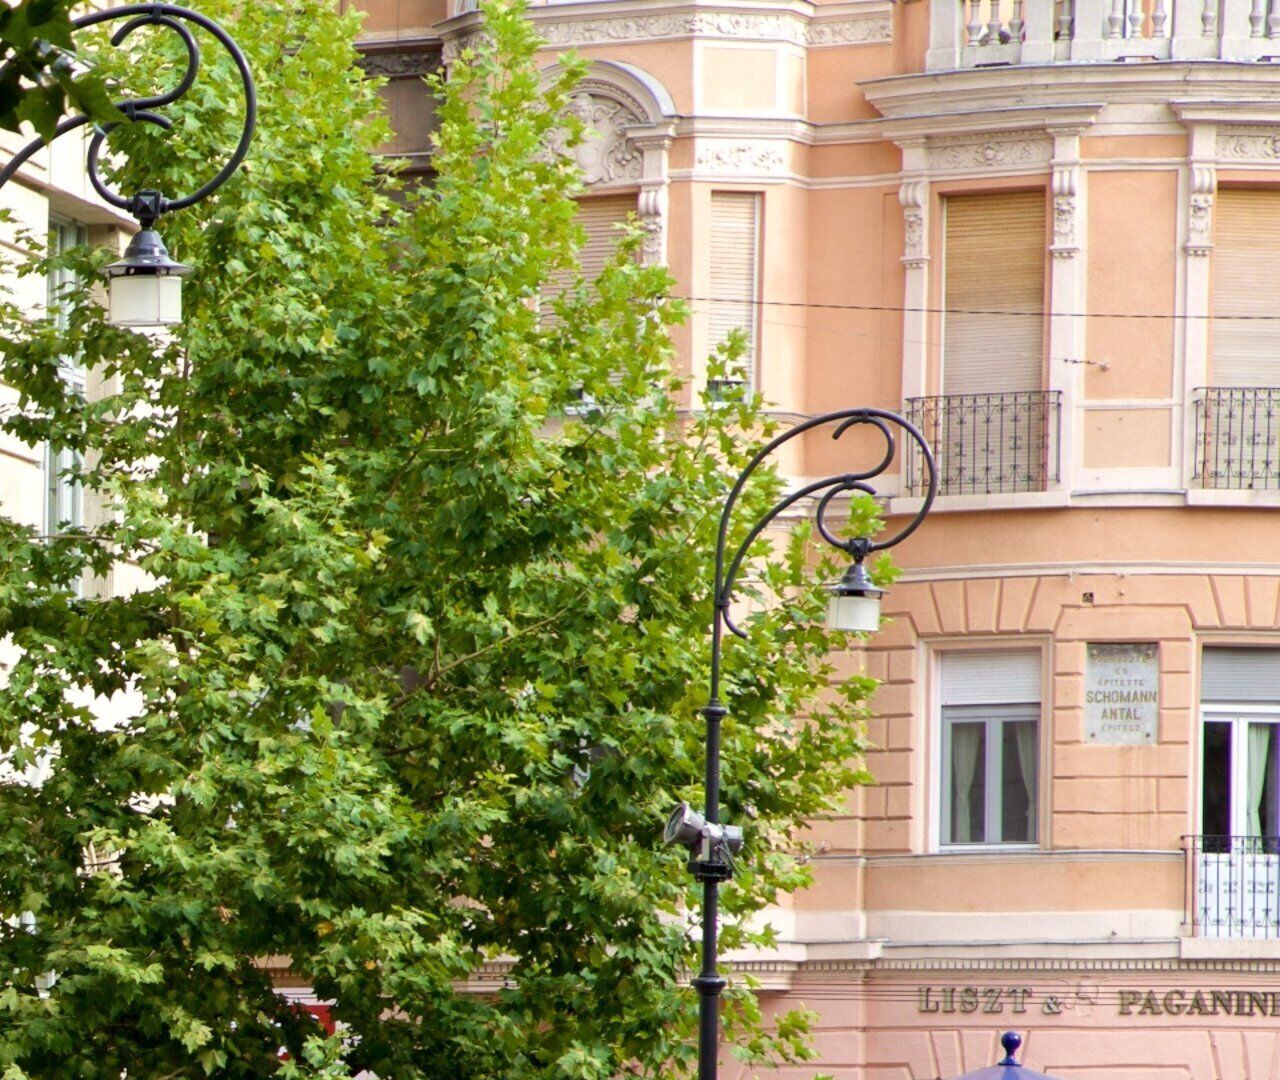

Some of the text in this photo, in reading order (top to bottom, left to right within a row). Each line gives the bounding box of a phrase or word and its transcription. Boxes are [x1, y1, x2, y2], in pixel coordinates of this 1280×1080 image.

[1102, 708, 1141, 720] ANTAL
[918, 986, 1033, 1013] LISZT
[1042, 995, 1063, 1015] &
